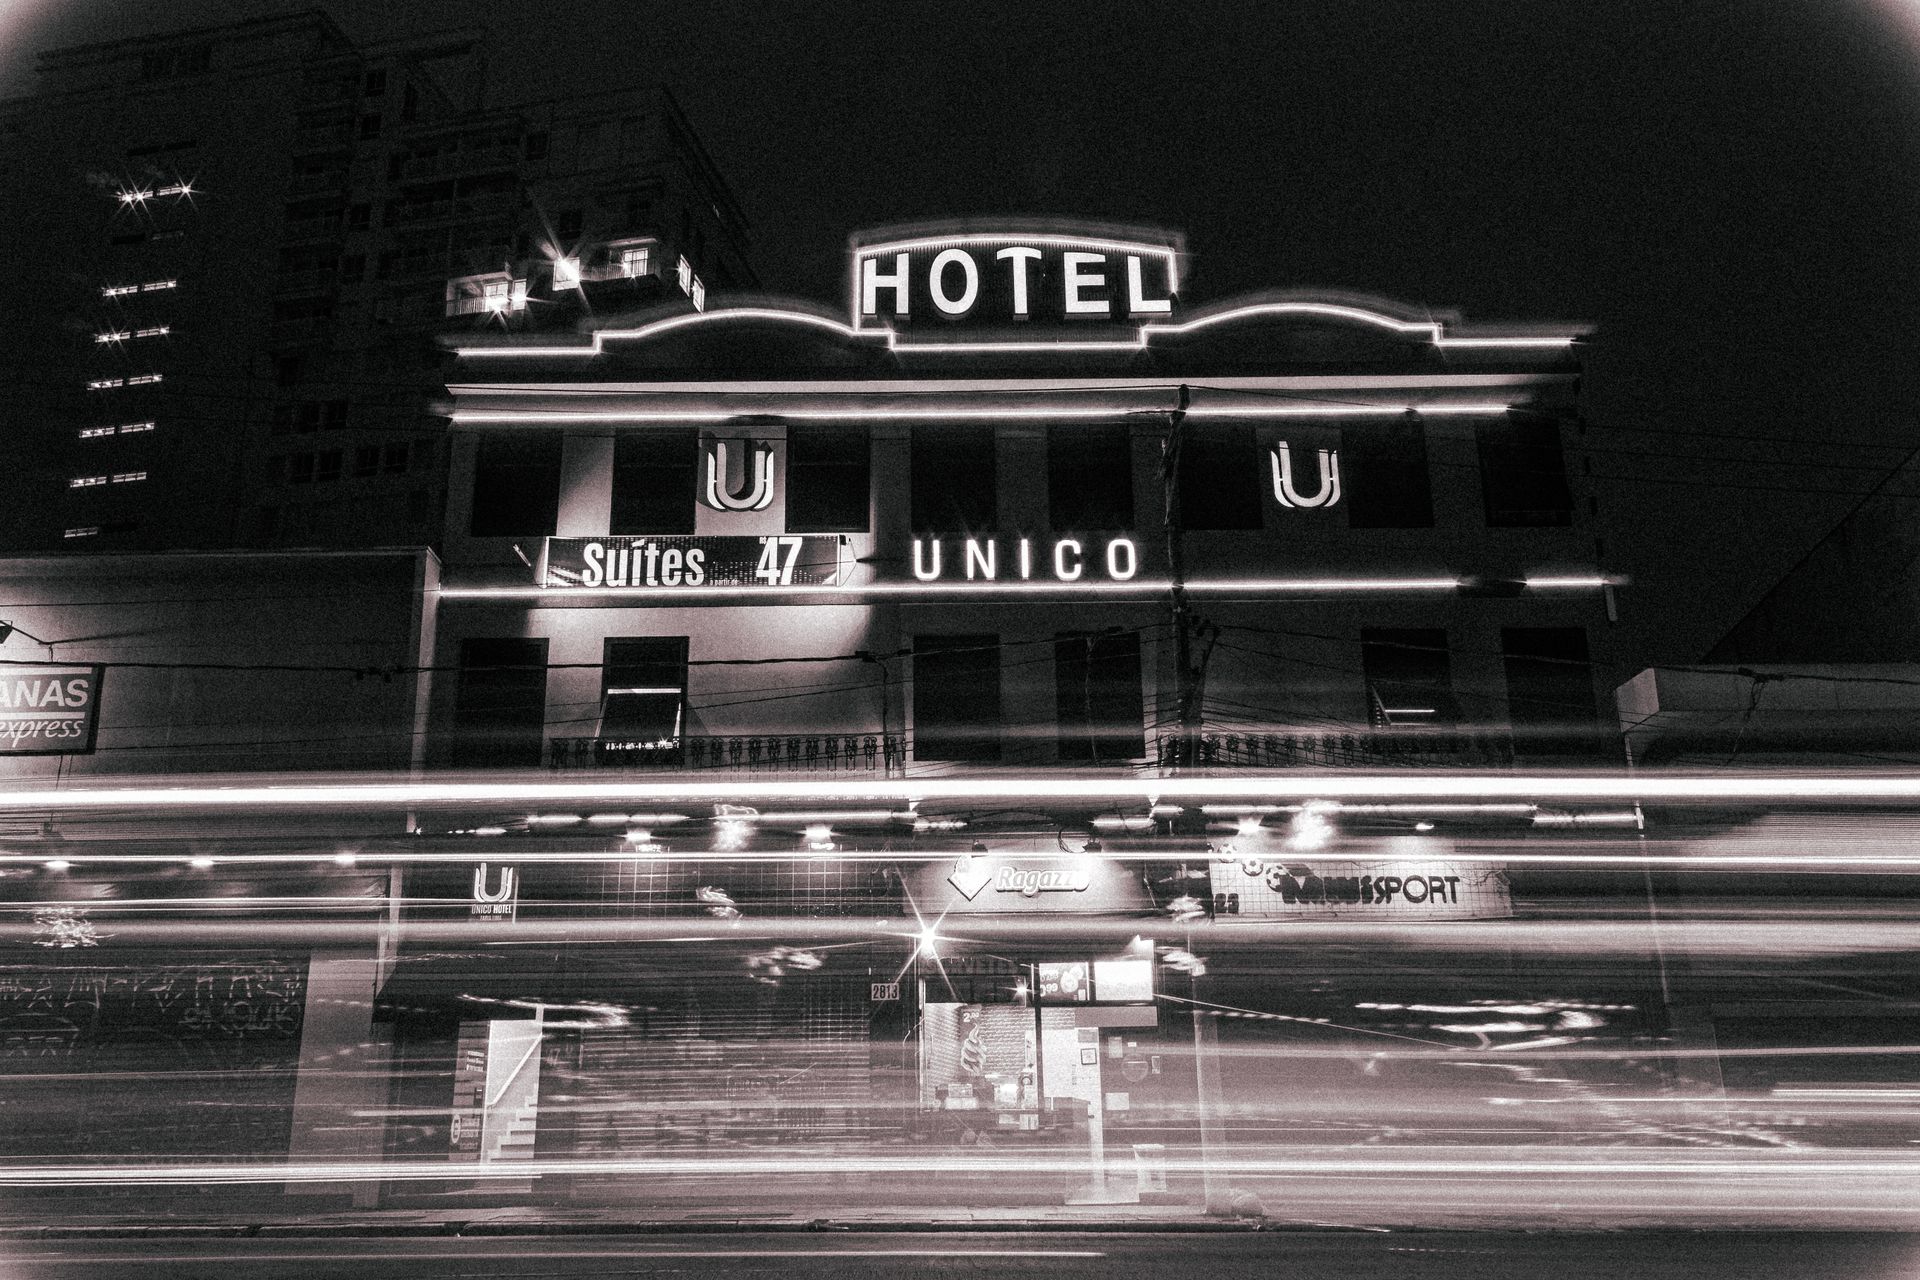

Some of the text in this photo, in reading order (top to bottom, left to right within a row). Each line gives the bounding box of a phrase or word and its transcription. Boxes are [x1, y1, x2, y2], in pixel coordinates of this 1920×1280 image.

[863, 247, 1171, 314] HOTEL
[582, 537, 802, 587] Suítes 47
[914, 539, 1136, 580] UNICO
[493, 904, 511, 913] HOTEL
[873, 984, 898, 999] 2813
